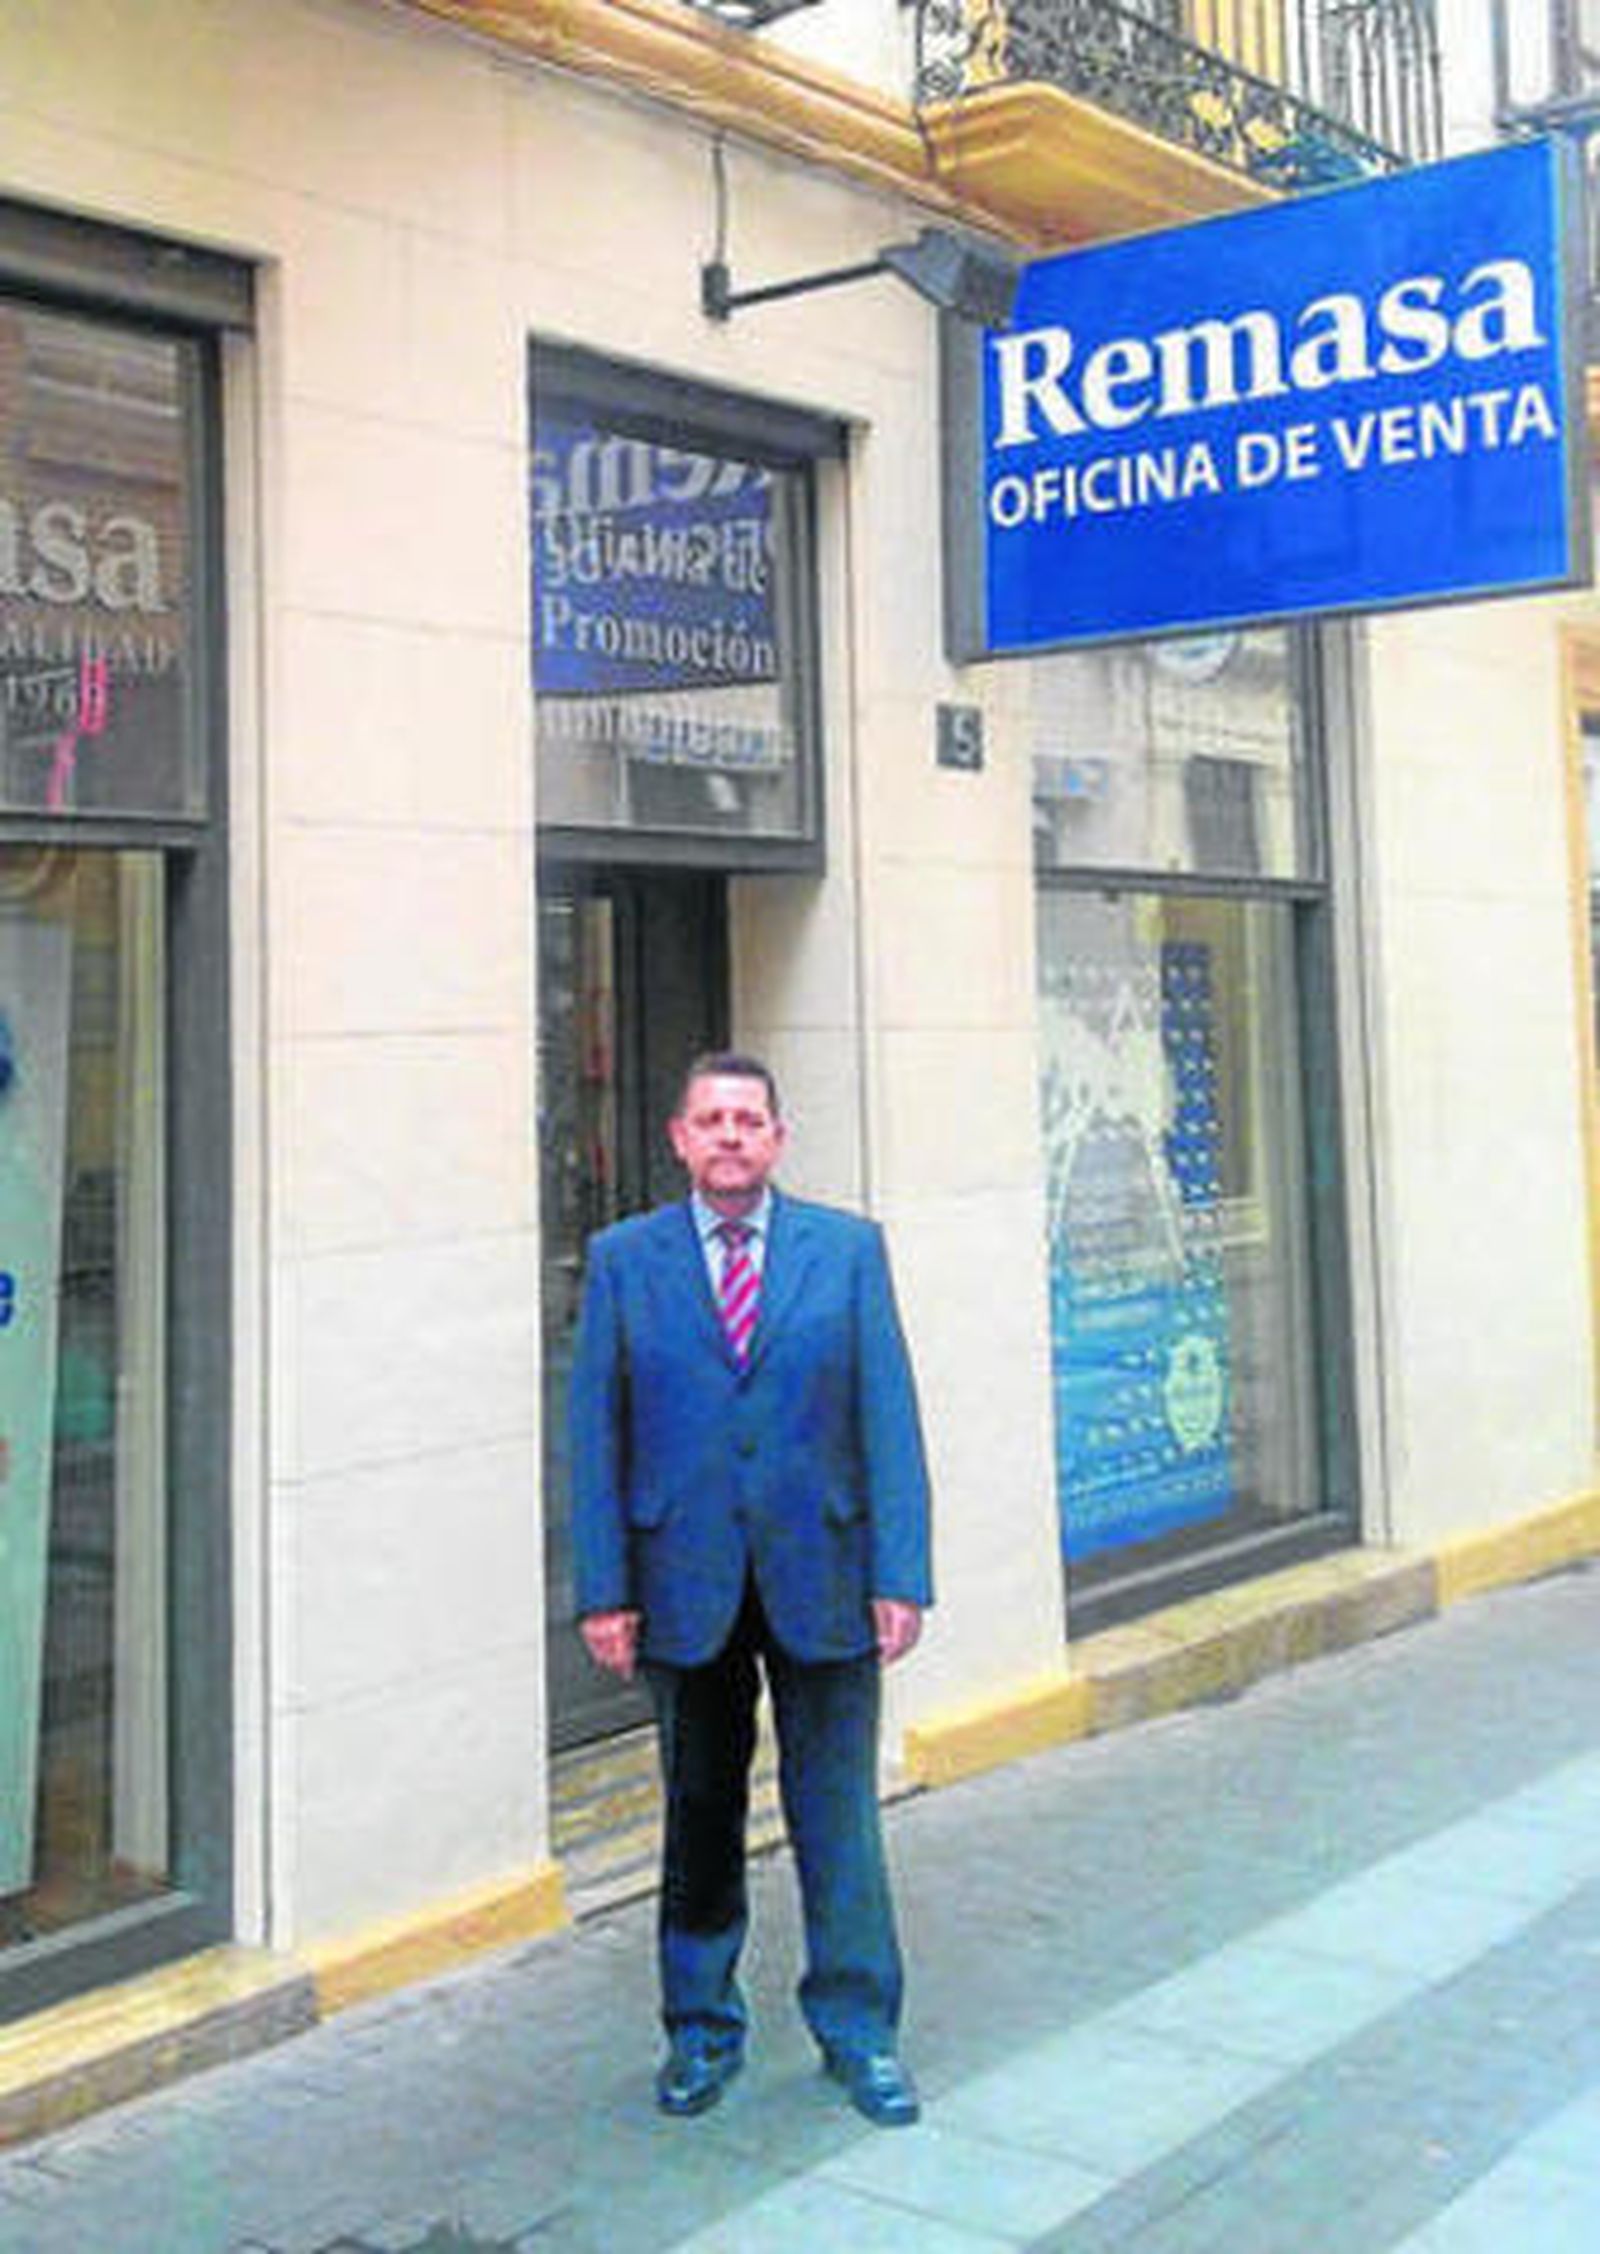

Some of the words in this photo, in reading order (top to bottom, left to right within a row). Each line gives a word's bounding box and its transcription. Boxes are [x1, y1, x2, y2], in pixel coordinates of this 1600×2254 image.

[993, 256, 1548, 450] Remasa
[990, 442, 1221, 528] OFICINA
[1235, 424, 1321, 488] DE
[1332, 384, 1557, 470] VENTA
[541, 594, 775, 677] Promoción
